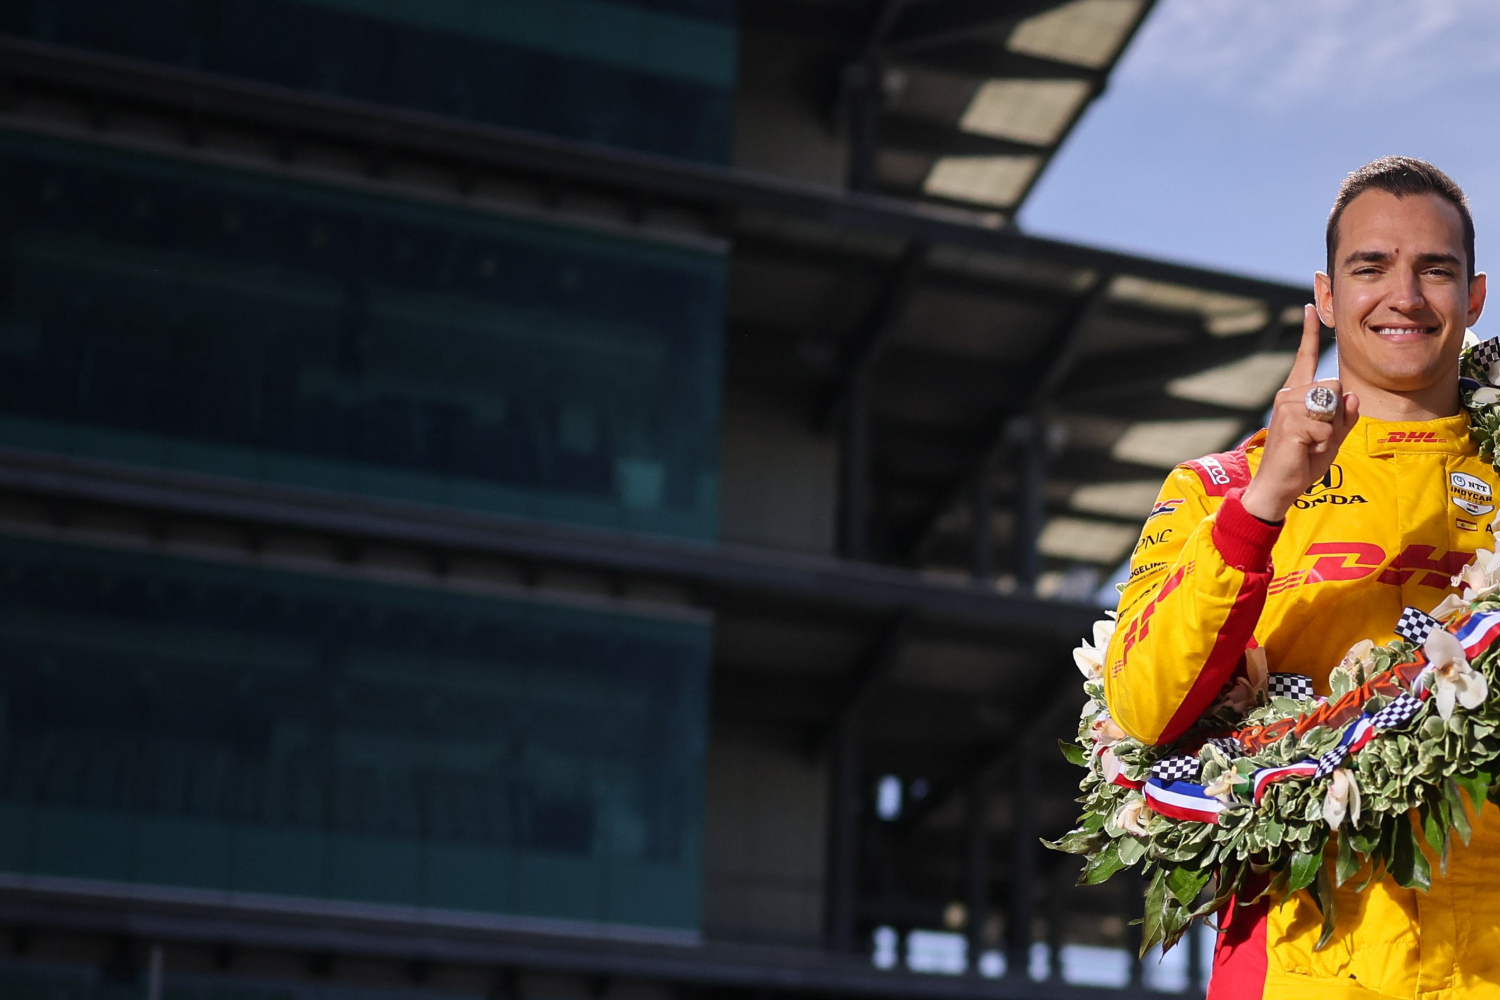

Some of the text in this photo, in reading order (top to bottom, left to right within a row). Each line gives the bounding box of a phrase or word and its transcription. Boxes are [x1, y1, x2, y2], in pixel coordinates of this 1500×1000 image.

[1386, 431, 1438, 443] DHL
[1450, 486, 1493, 502] INDYCAR
[1467, 481, 1488, 492] NTT
[1291, 494, 1368, 510] ONDA
[1134, 528, 1173, 555] PNC
